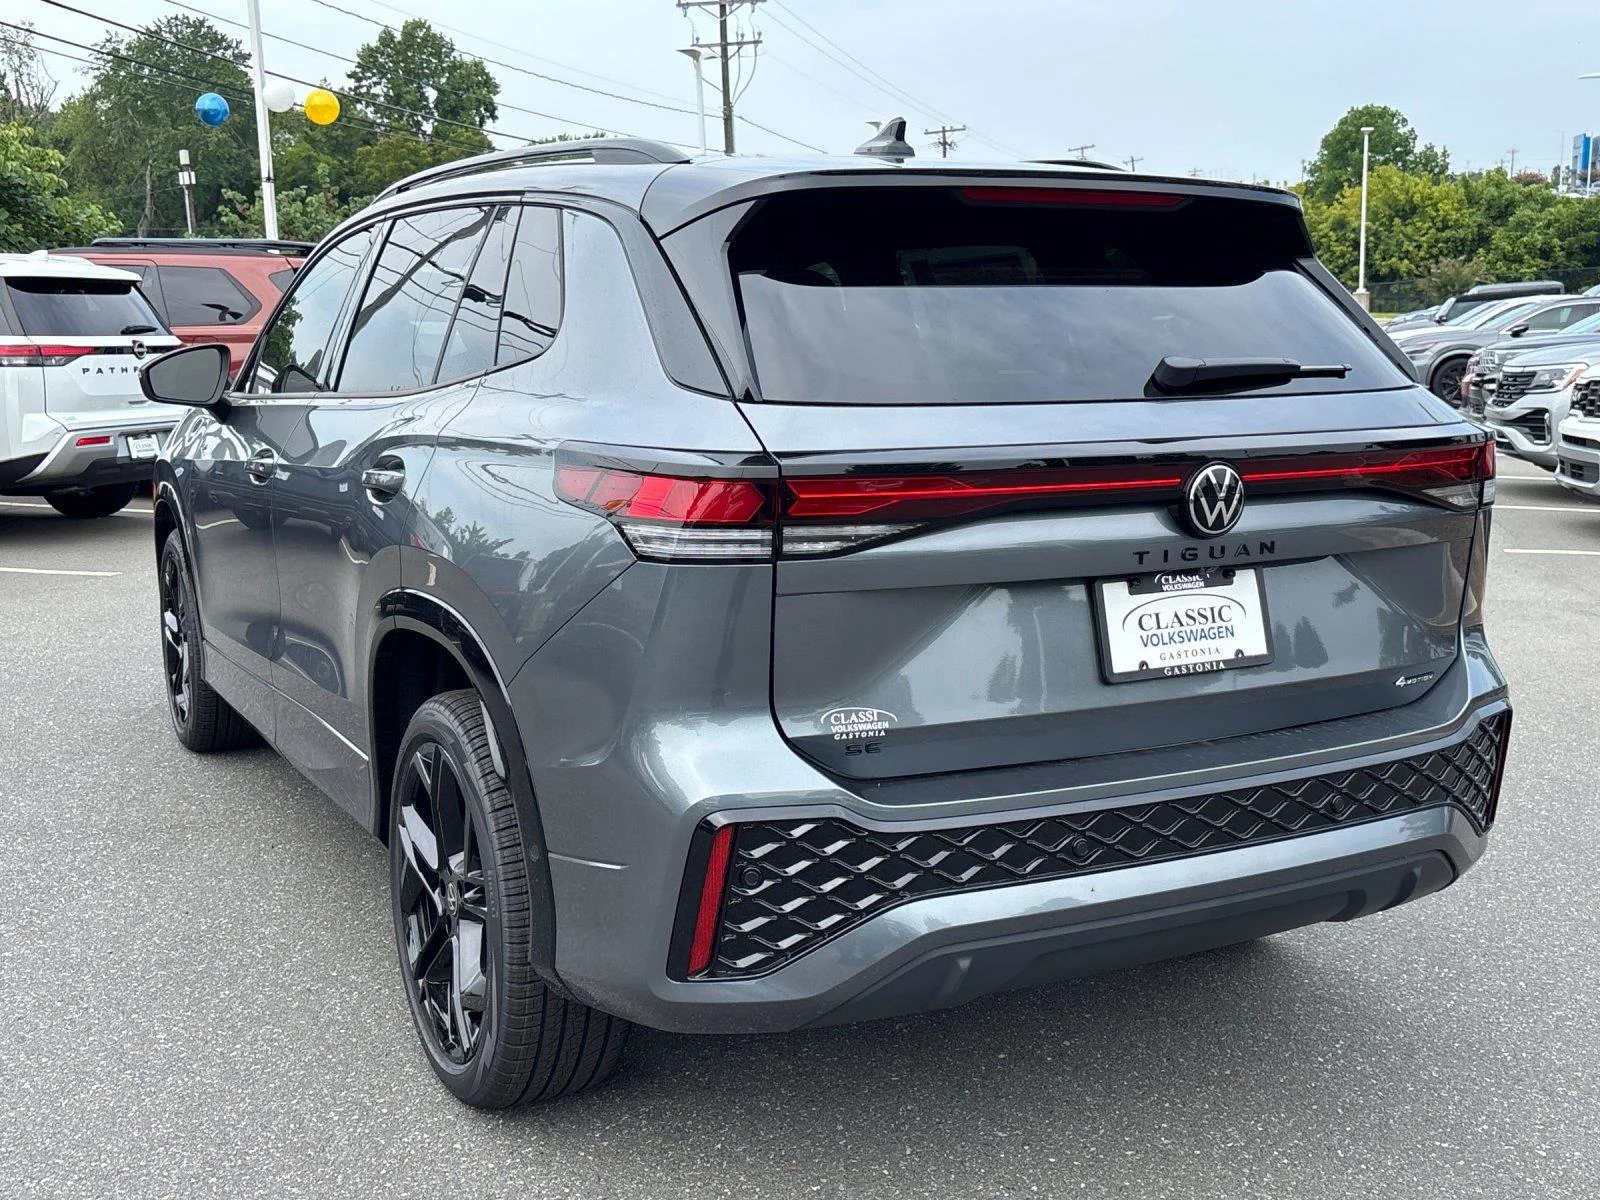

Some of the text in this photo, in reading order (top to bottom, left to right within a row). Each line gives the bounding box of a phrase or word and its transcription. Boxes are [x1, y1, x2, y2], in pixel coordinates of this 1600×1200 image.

[1132, 540, 1276, 565] TIGUAN
[1161, 581, 1205, 592] VOLKSWAGEN
[1138, 604, 1233, 632] CLASSIC
[1140, 625, 1235, 648] VOLKSWAGEN
[1159, 646, 1221, 661] GASTONIA
[1164, 660, 1226, 676] GASTONIA
[830, 721, 889, 733] VOLKSWAGEN
[834, 729, 886, 741] GASTONIA
[845, 741, 882, 757] SE
